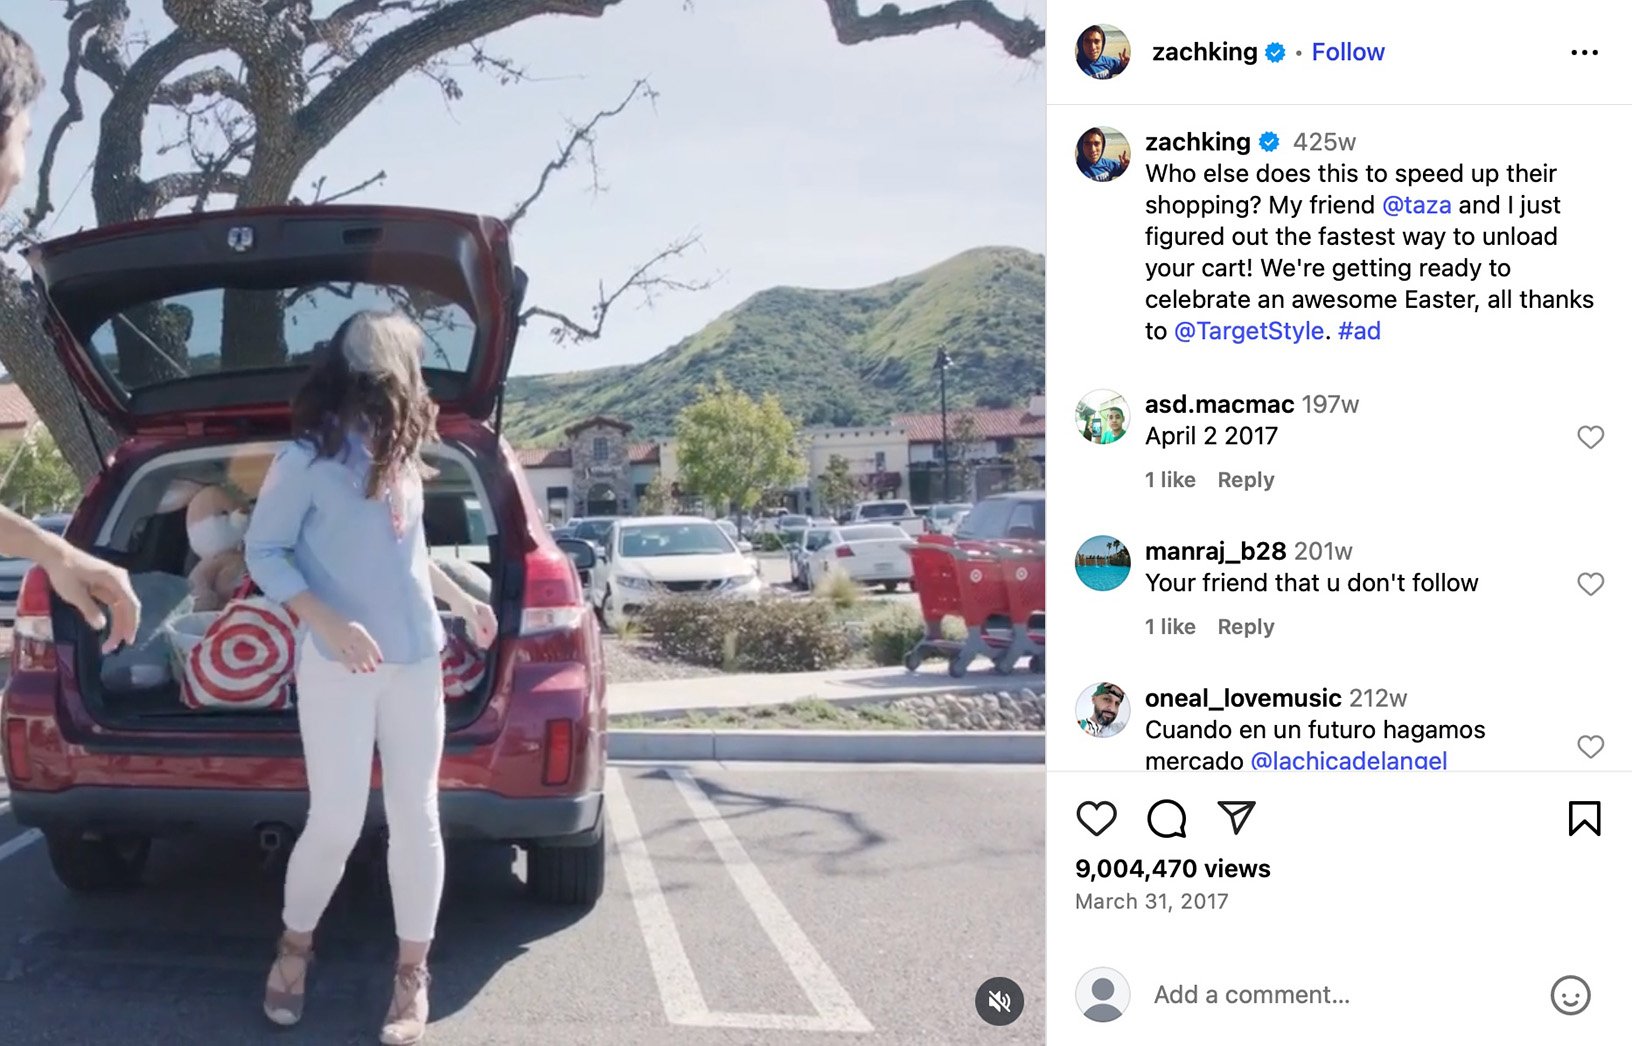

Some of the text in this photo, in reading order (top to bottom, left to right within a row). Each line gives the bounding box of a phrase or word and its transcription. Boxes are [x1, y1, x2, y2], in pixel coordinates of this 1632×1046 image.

[1153, 41, 1385, 65] zachking Follow
[1146, 131, 1356, 155] zachking 425w
[1146, 163, 1557, 187] Who else does this to speed up their
[1146, 195, 1560, 218] shopping? My friend @taza and I just
[1145, 226, 1557, 250] figured out the fastest way to unload
[1145, 258, 1511, 281] your cart! We're getting ready to
[1146, 289, 1594, 312] celebrate an awesome Easter, all thanks
[1145, 321, 1380, 344] to @TargetStyle. #ad
[1146, 394, 1359, 413] asd.macmac 197w
[1145, 426, 1278, 449] April 2 2017
[1146, 471, 1195, 487] 1 like
[1219, 471, 1274, 491] Reply
[1146, 540, 1352, 564] manraj_b28 201w
[1145, 573, 1479, 592] Your friend that u don't follow
[1146, 618, 1195, 634] 1 like
[1219, 618, 1275, 638] Reply
[1146, 687, 1407, 711] oneal_lovemusic 212w
[1146, 720, 1485, 743] Cuando en un futuro hagamos
[1146, 751, 1243, 770] mercado
[1076, 858, 1270, 882] 9,004,470 views
[1077, 893, 1228, 912] March 31, 2017
[1154, 985, 1349, 1003] Add a comment...
